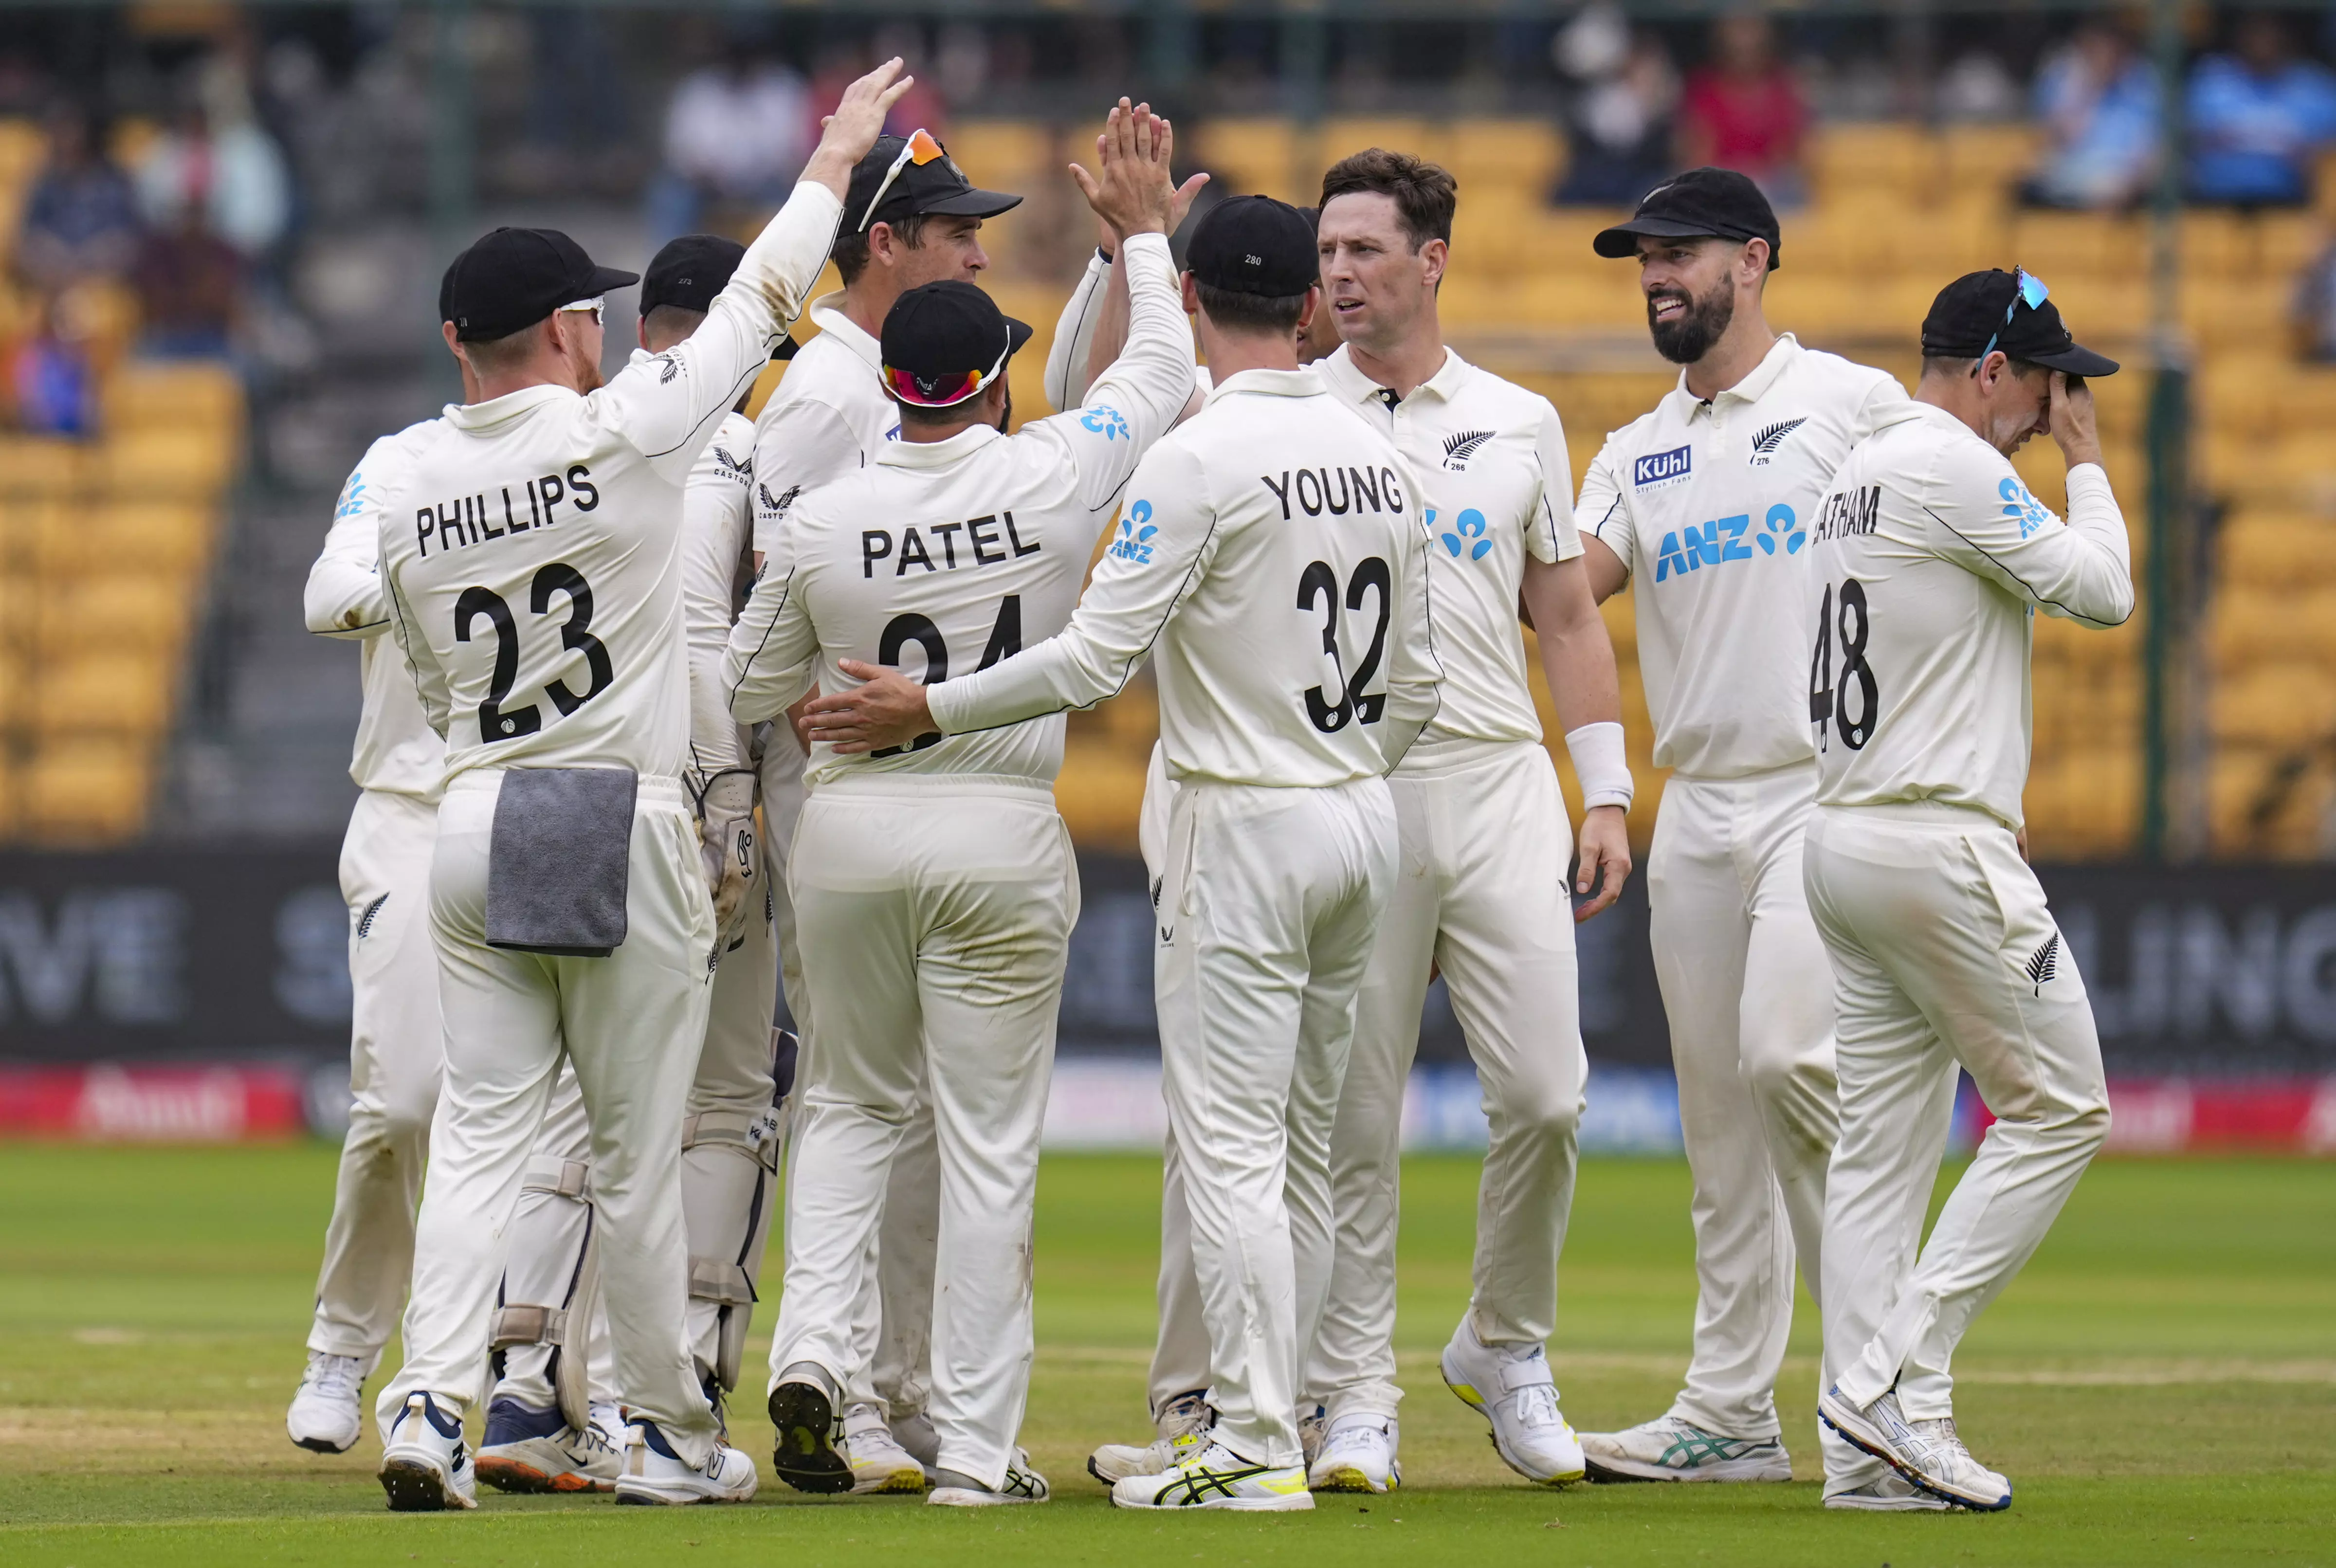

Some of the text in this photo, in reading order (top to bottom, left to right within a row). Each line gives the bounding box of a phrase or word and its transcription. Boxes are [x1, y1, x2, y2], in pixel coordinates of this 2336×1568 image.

[1245, 254, 1261, 266] 280
[1261, 466, 1403, 520] YOUNG
[1451, 463, 1465, 472] 266
[1636, 475, 1692, 494] Stylish Fans
[1638, 449, 1687, 481] Kühl
[417, 465, 599, 557] PHILLIPS
[862, 511, 1041, 578] PATEL
[1110, 539, 1154, 565] ANZ
[1656, 514, 1752, 583] ANZ
[455, 563, 614, 744] 23
[1296, 557, 1390, 733] 32
[1809, 578, 1879, 753] 48
